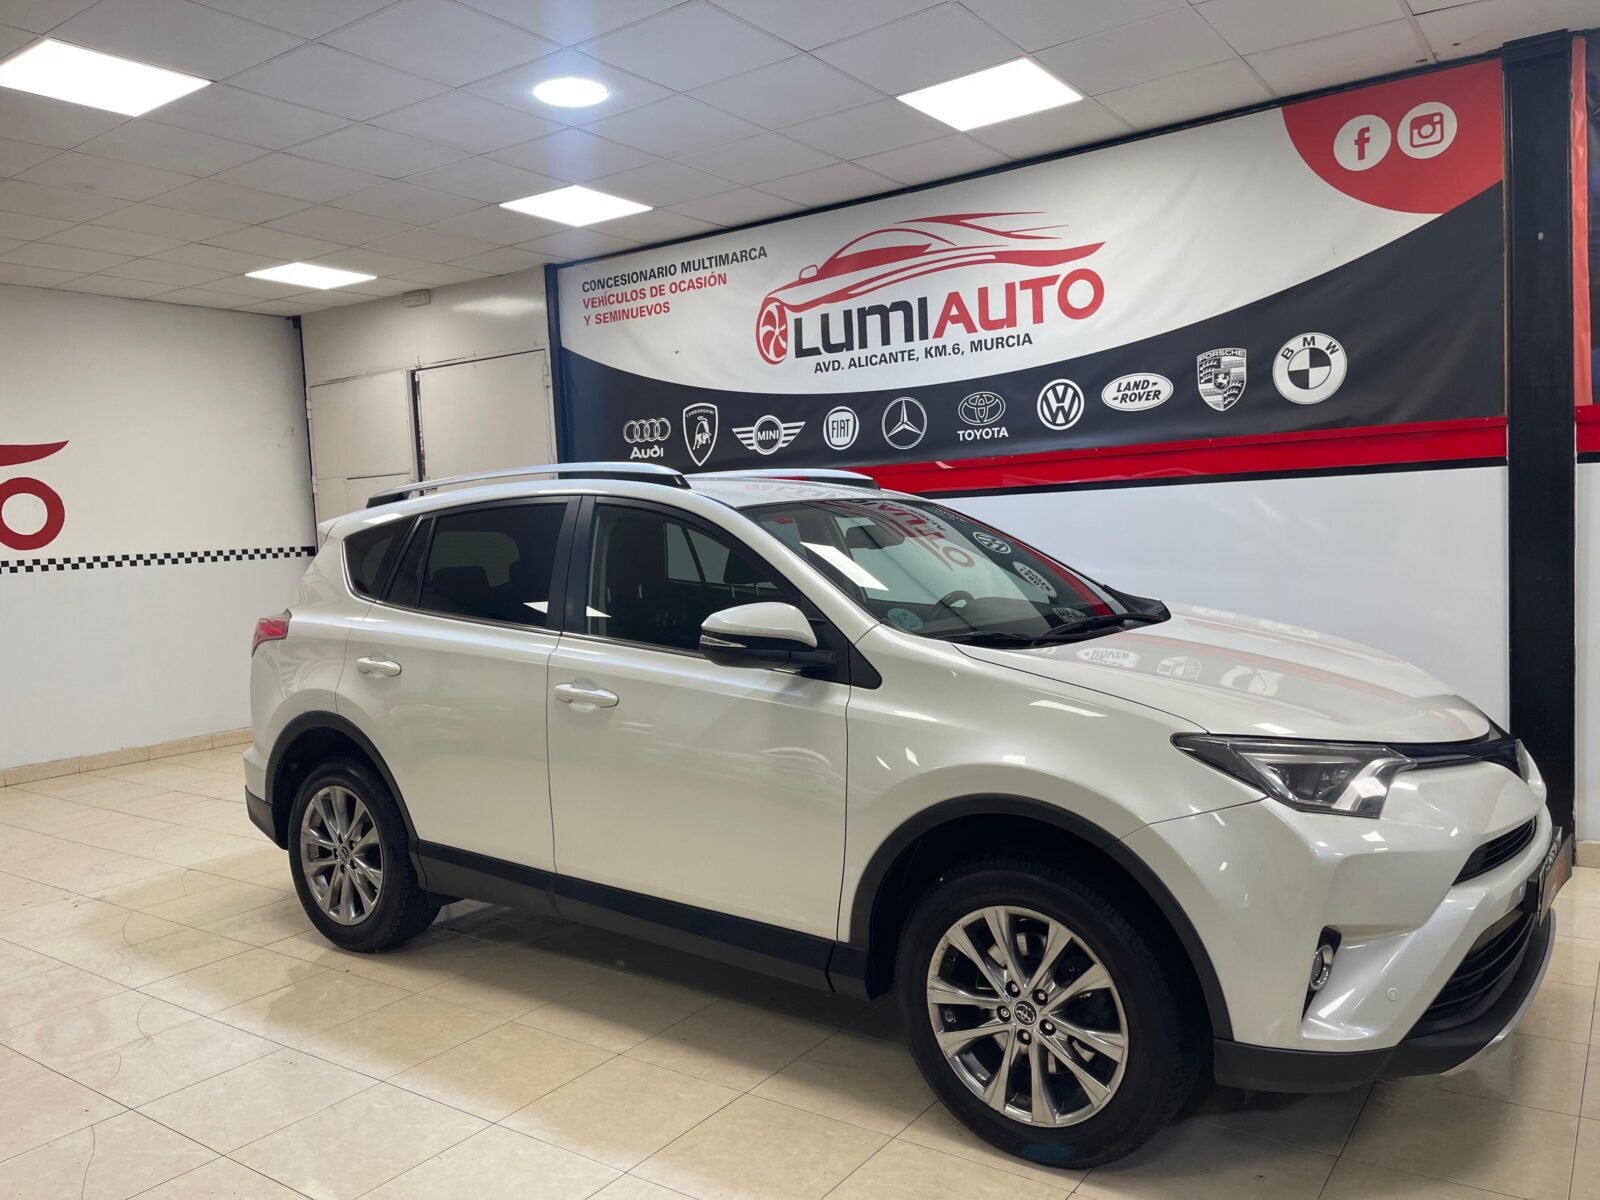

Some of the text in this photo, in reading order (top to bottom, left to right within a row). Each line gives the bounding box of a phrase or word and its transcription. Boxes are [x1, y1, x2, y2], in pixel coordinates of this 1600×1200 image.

[582, 245, 768, 293] CONCESIONARIO MULTIMARCA
[582, 271, 728, 310] VEHÍCULOS DE OCASIÓN
[583, 301, 671, 326] Y SEMINUEVOS
[813, 332, 1033, 374] AVD. ALICANTE, KM.6, MURCIA
[1199, 349, 1246, 361] PORSCHE
[1281, 335, 1340, 360] BMW
[685, 408, 715, 418] LAMBORGHINI
[757, 428, 780, 442] MINI
[831, 418, 851, 439] FIAT
[957, 426, 1009, 442] TOYOTA
[629, 446, 664, 460] Audi
